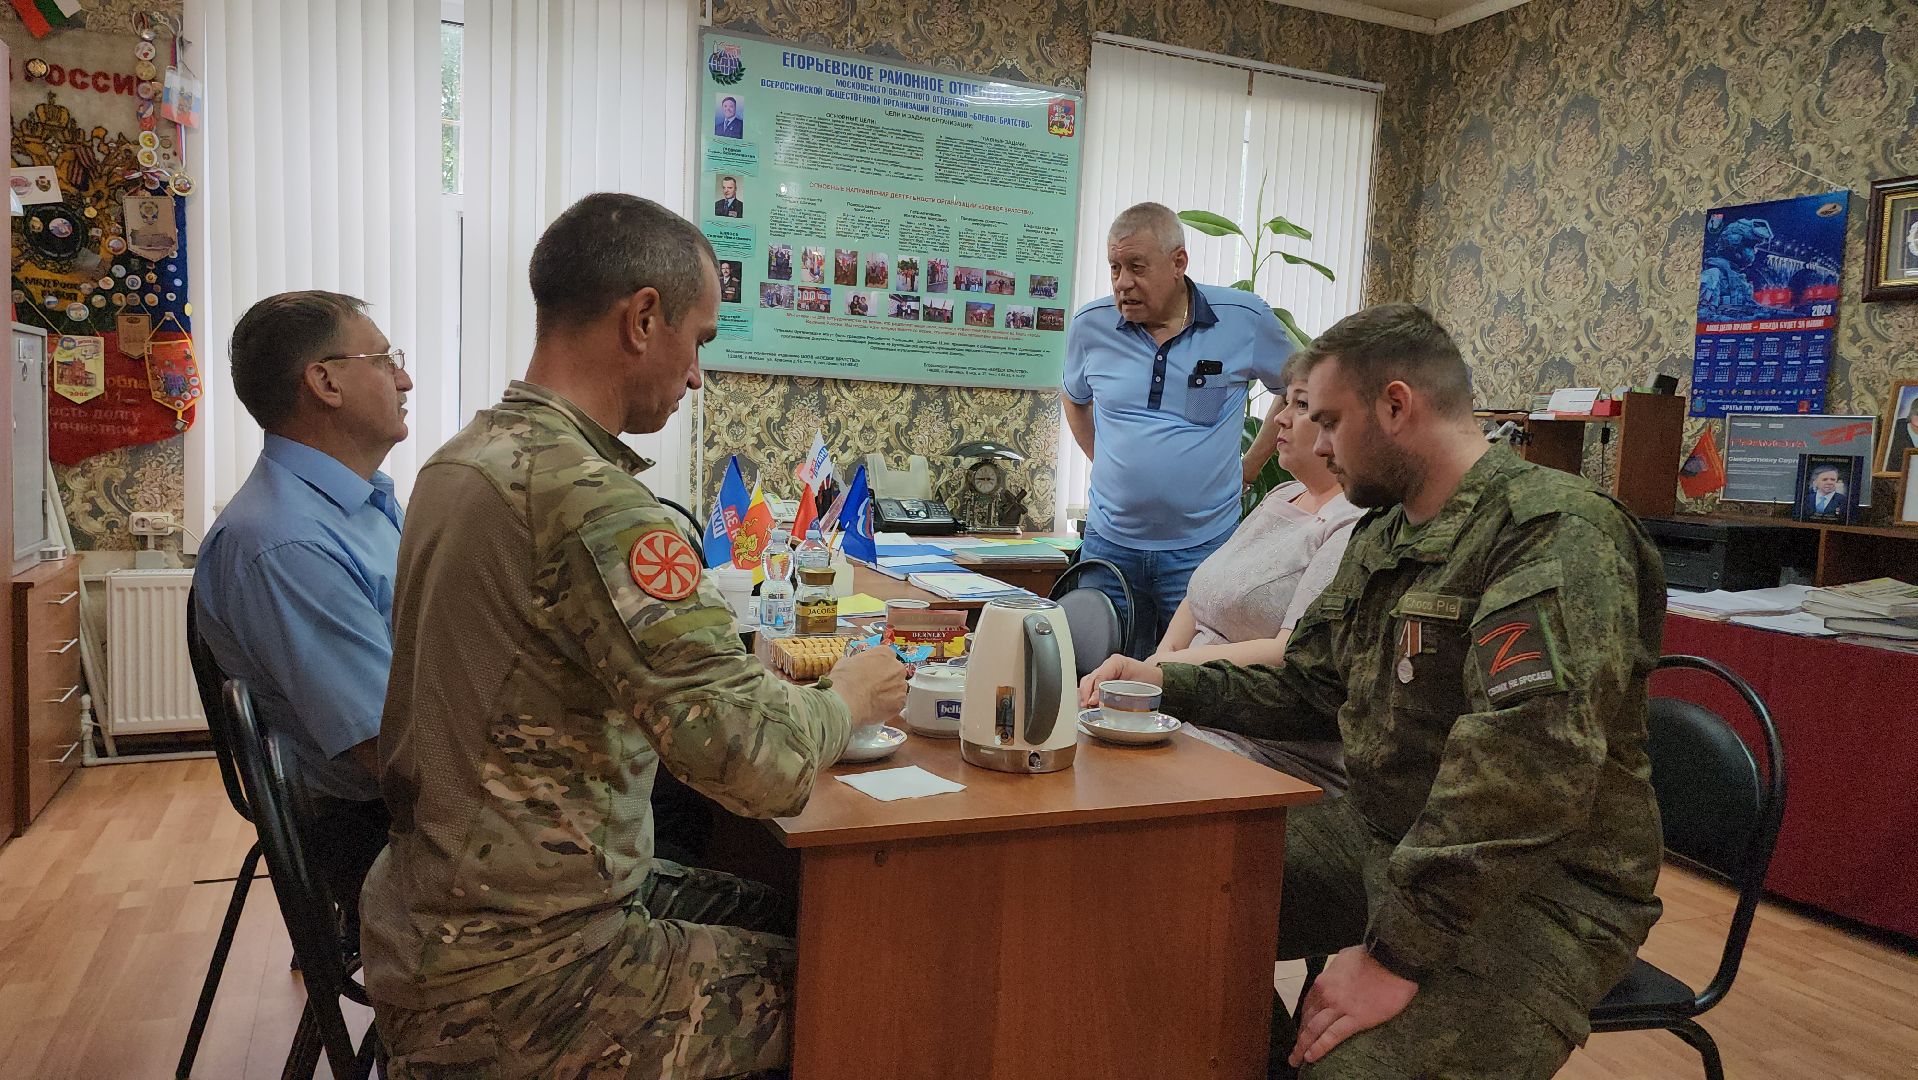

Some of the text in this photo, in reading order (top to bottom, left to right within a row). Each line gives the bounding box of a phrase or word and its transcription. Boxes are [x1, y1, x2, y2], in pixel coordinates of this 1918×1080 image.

[782, 51, 874, 81] ЕГОРЬЕВСКОЕ
[879, 68, 944, 93] РАЙОННОЕ
[835, 79, 886, 94] МОСКОВСКОГО
[888, 88, 930, 102] ОБЛАСТНОГО
[761, 79, 823, 96] ВСЕРОССИЙСКОЙ
[825, 88, 881, 105] ОБЩЕСТВЕННОЙ
[883, 98, 930, 113] ОРГАНИЗАЦИИ
[931, 103, 968, 119] ВЕТЕРАНОВ
[825, 112, 858, 122] ОСНОВНЫЕ
[884, 110, 901, 118] ЦЕЛИ
[936, 198, 977, 209] ОРГАНИЗАЦИИ
[1811, 304, 1832, 317] 2024
[807, 607, 836, 615] JACOBS
[1437, 599, 1457, 613] Pie
[1477, 622, 1542, 678] Z
